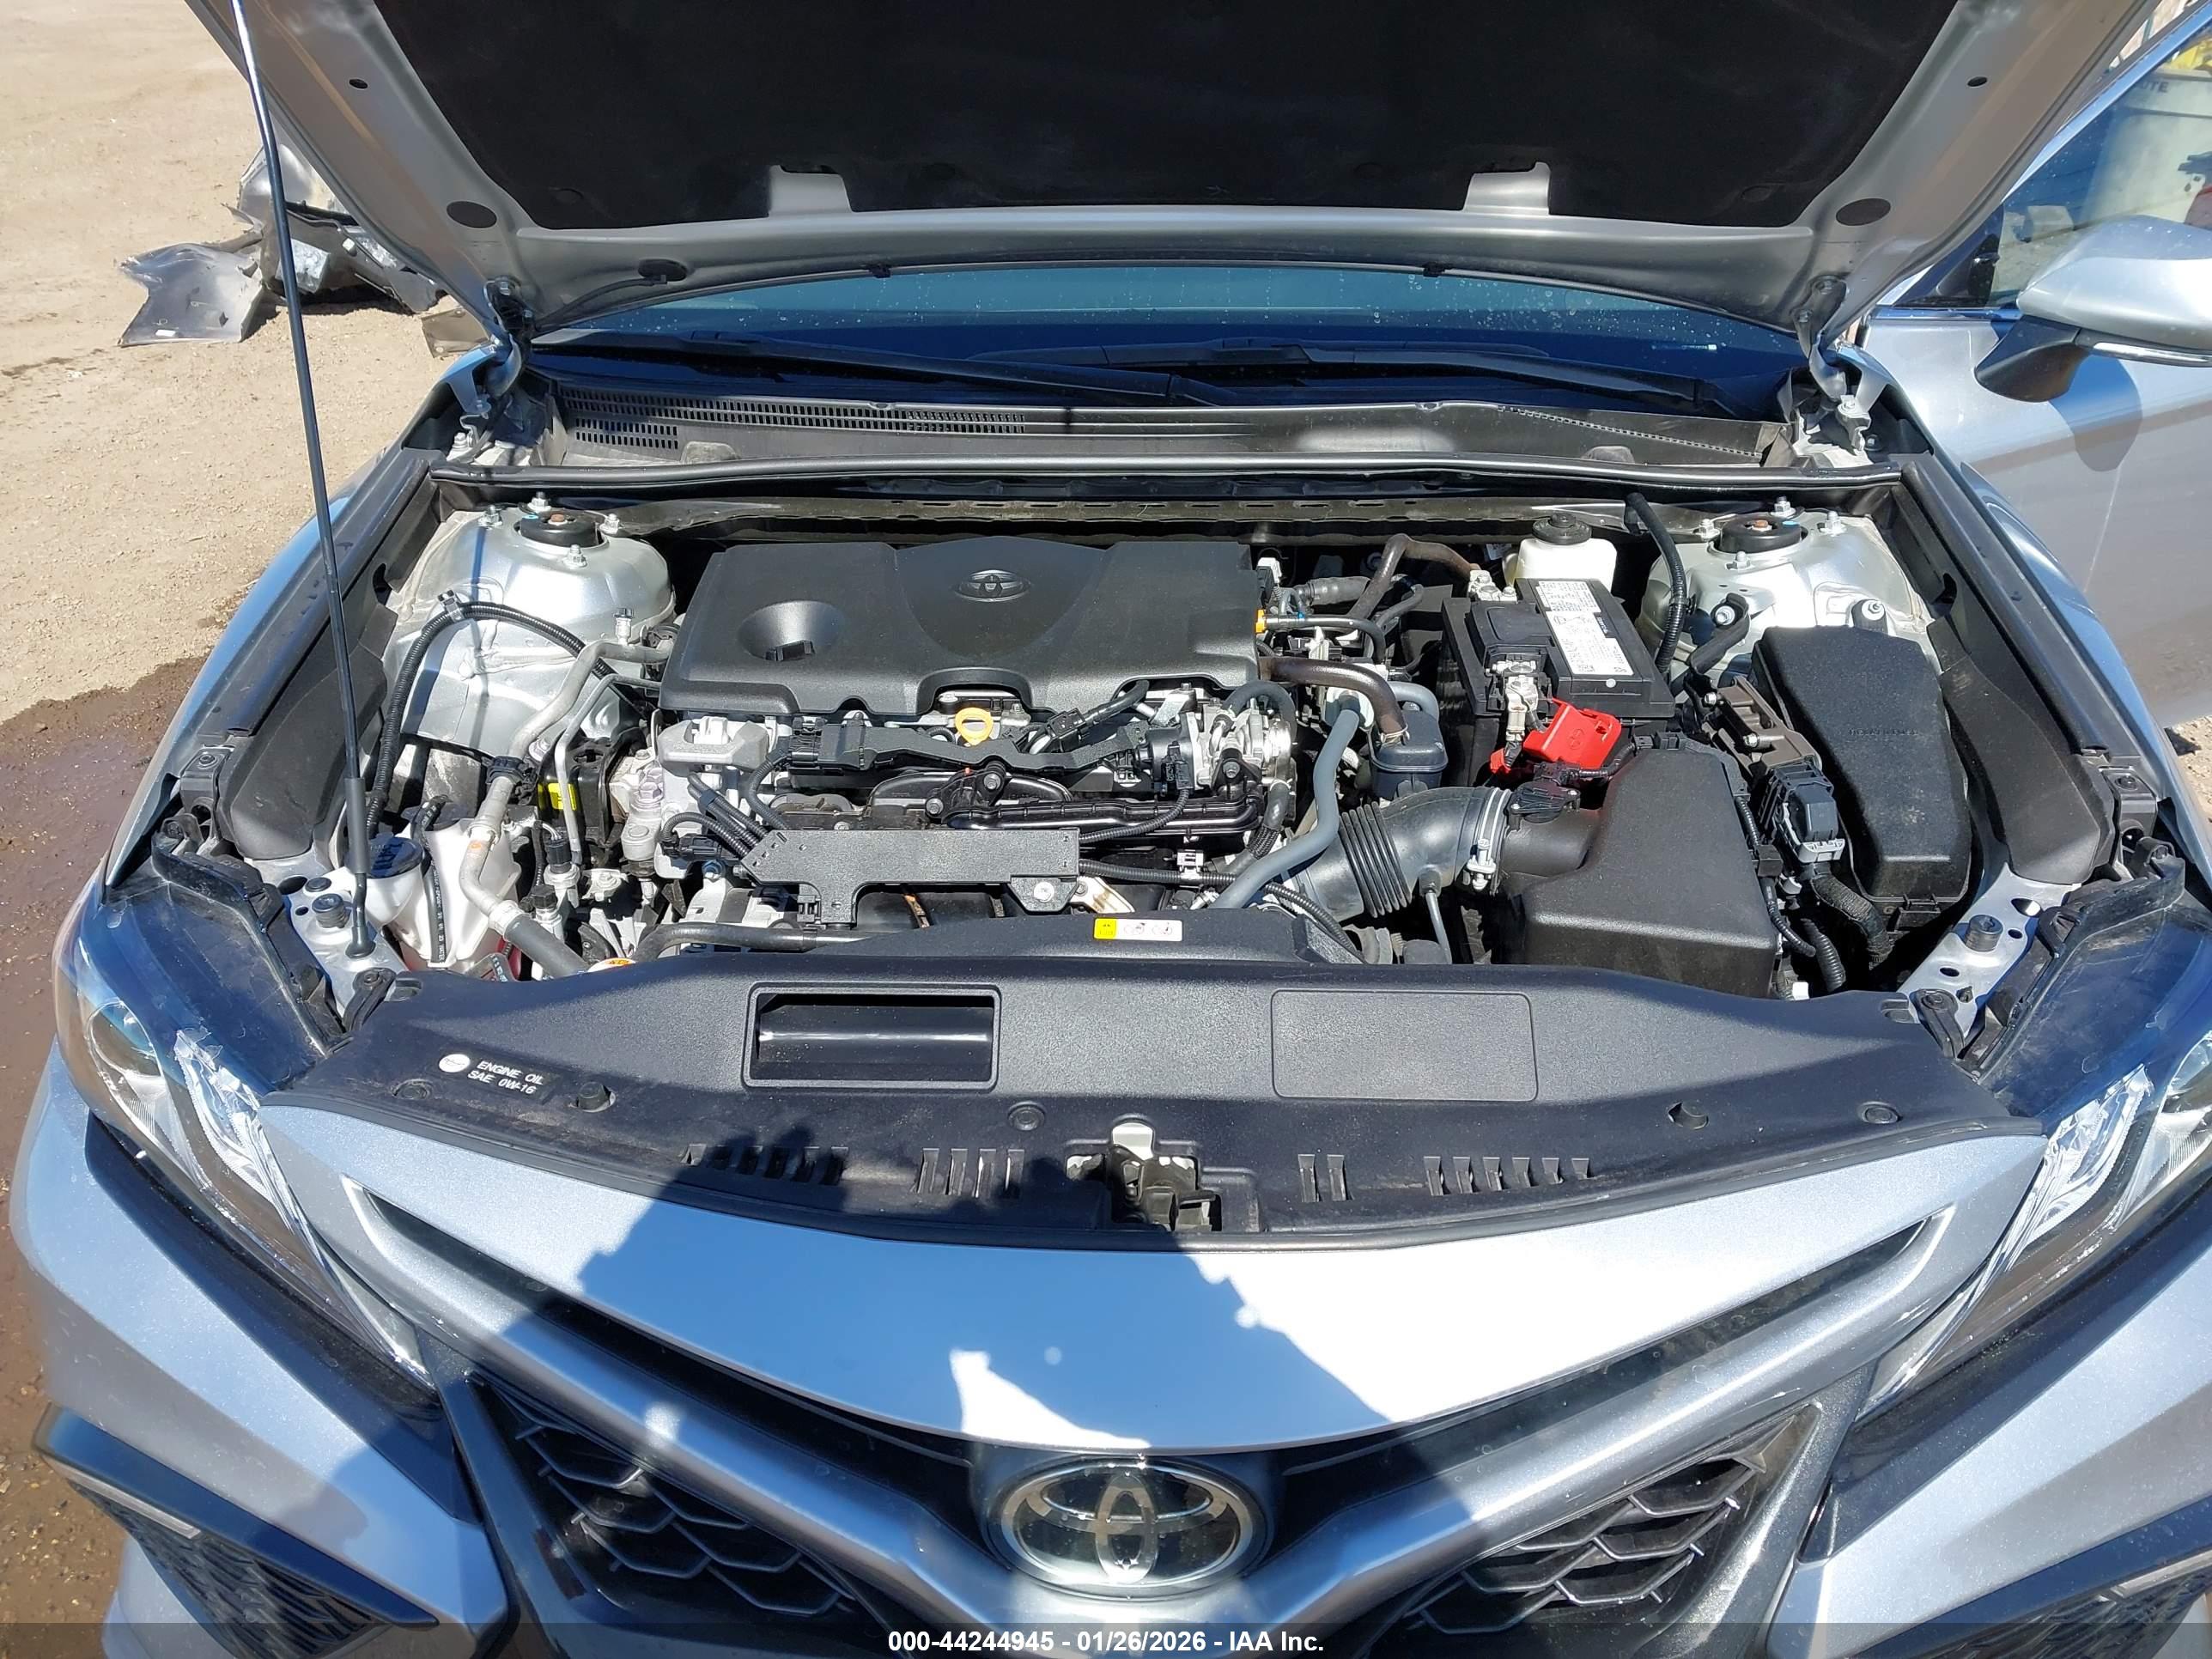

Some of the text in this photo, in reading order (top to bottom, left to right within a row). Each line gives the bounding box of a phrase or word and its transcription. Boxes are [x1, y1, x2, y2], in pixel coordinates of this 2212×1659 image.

[467, 1070, 537, 1094] SAE 0W-16
[477, 1060, 544, 1085] ENGINE OIL
